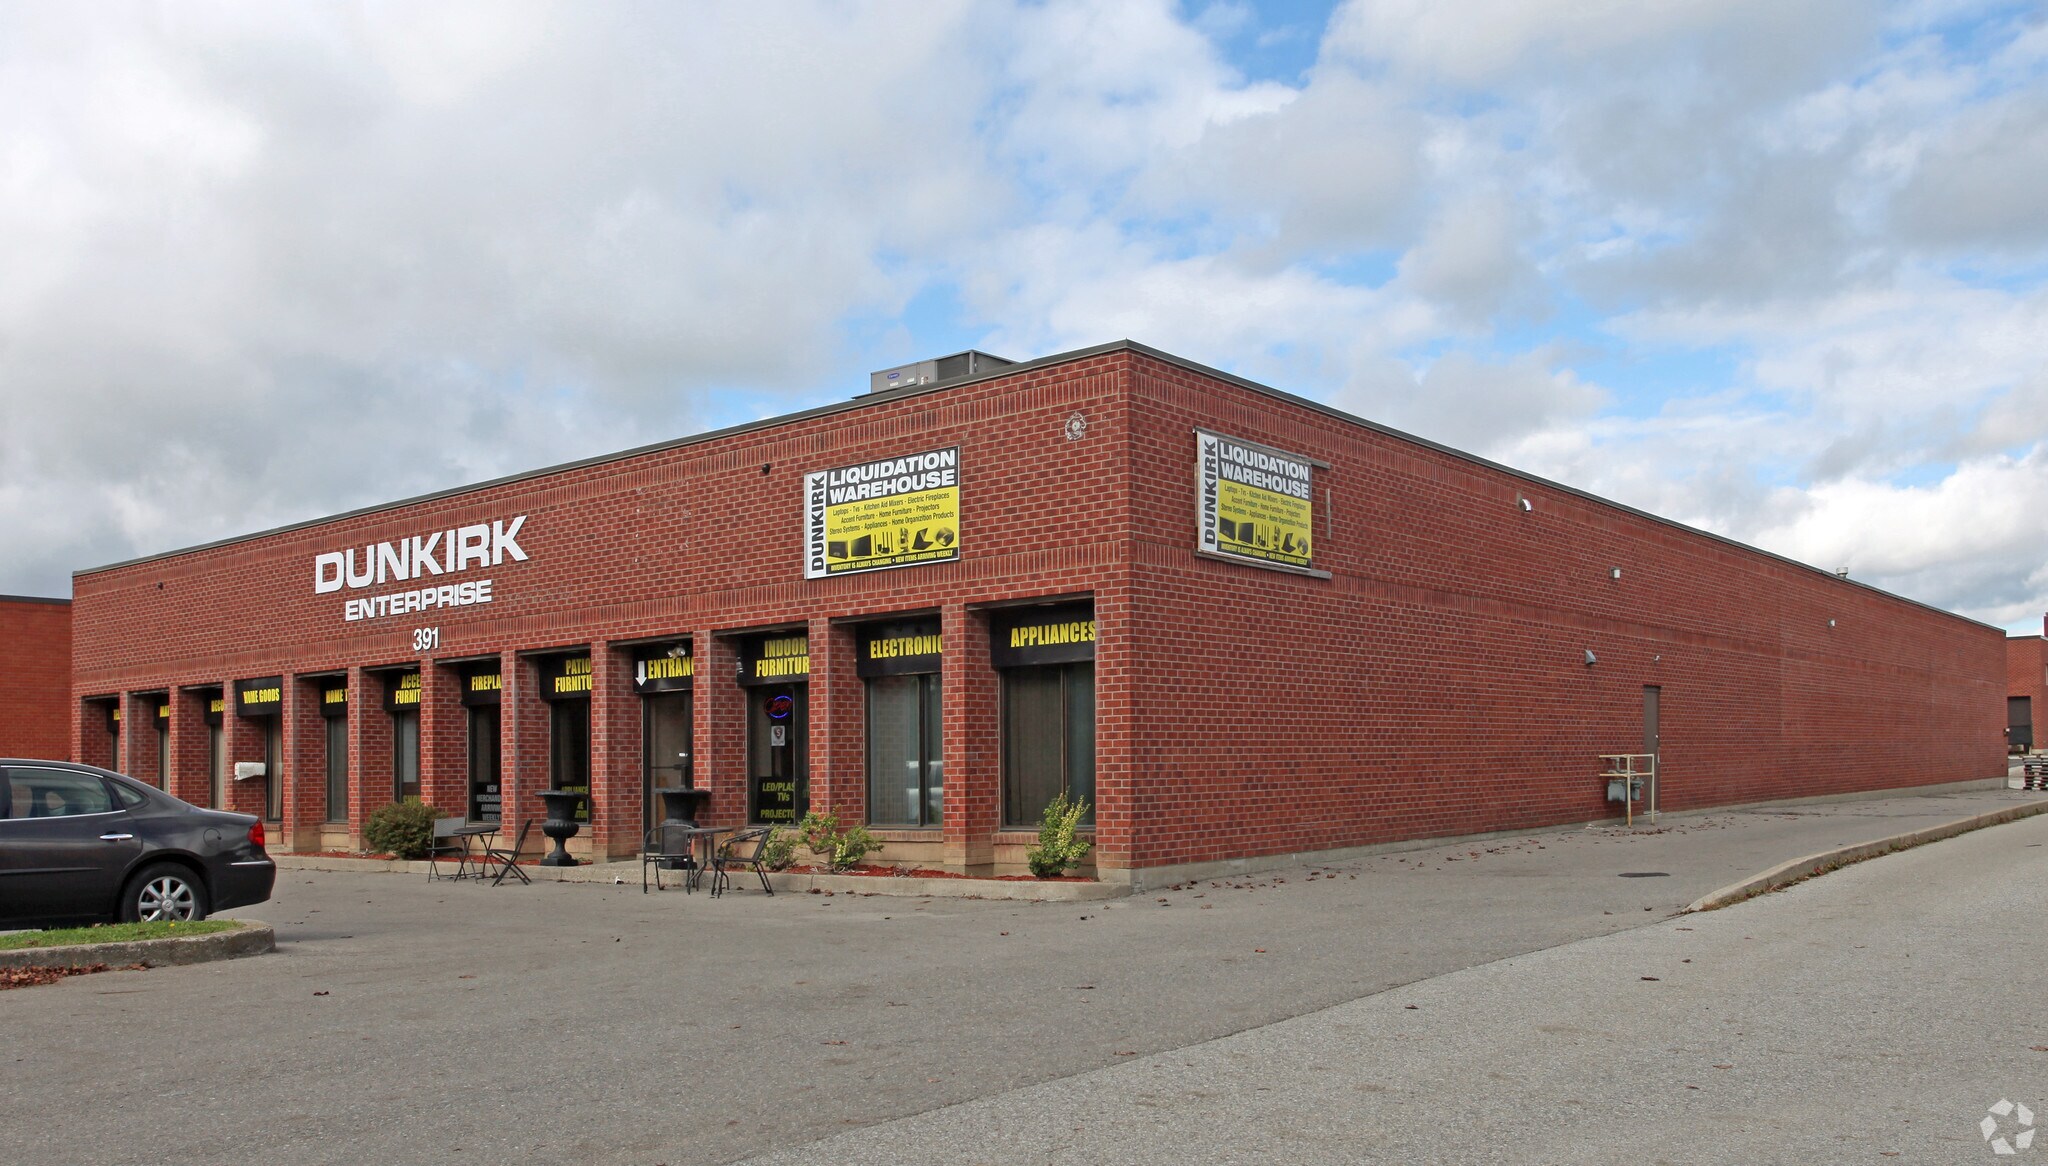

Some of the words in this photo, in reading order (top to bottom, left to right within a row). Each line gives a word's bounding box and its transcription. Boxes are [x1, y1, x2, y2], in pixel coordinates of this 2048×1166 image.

[830, 450, 955, 486] LIQUIDATION
[1220, 443, 1309, 482] LIQUIDATION
[830, 469, 955, 504] WAREHOUSE
[1204, 440, 1216, 544] DUNKIRK
[1220, 462, 1309, 499] WAREHOUSE
[832, 508, 849, 516] Laptops
[864, 503, 880, 511] Kitchen
[908, 496, 924, 504] Electric
[925, 492, 950, 502] Fireplaces
[841, 516, 855, 524] Accent
[856, 513, 875, 521] Furniture
[892, 508, 912, 516] Furniture
[916, 504, 940, 512] Projectors
[812, 476, 825, 571] DUNKIRK
[830, 527, 842, 535] Stereo
[843, 525, 861, 534] Systems
[864, 520, 888, 530] Appliances
[933, 511, 954, 519] Products
[315, 515, 528, 594] DUNKIRK
[937, 550, 953, 558] WEEKLY
[345, 580, 492, 621] ENTERPRISE
[413, 626, 440, 650] 391
[1010, 620, 1096, 648] APPLIANCES
[764, 637, 806, 658] INDOOR
[565, 657, 591, 675] PATIO
[259, 688, 280, 702] GOODS
[777, 792, 790, 802] TVs
